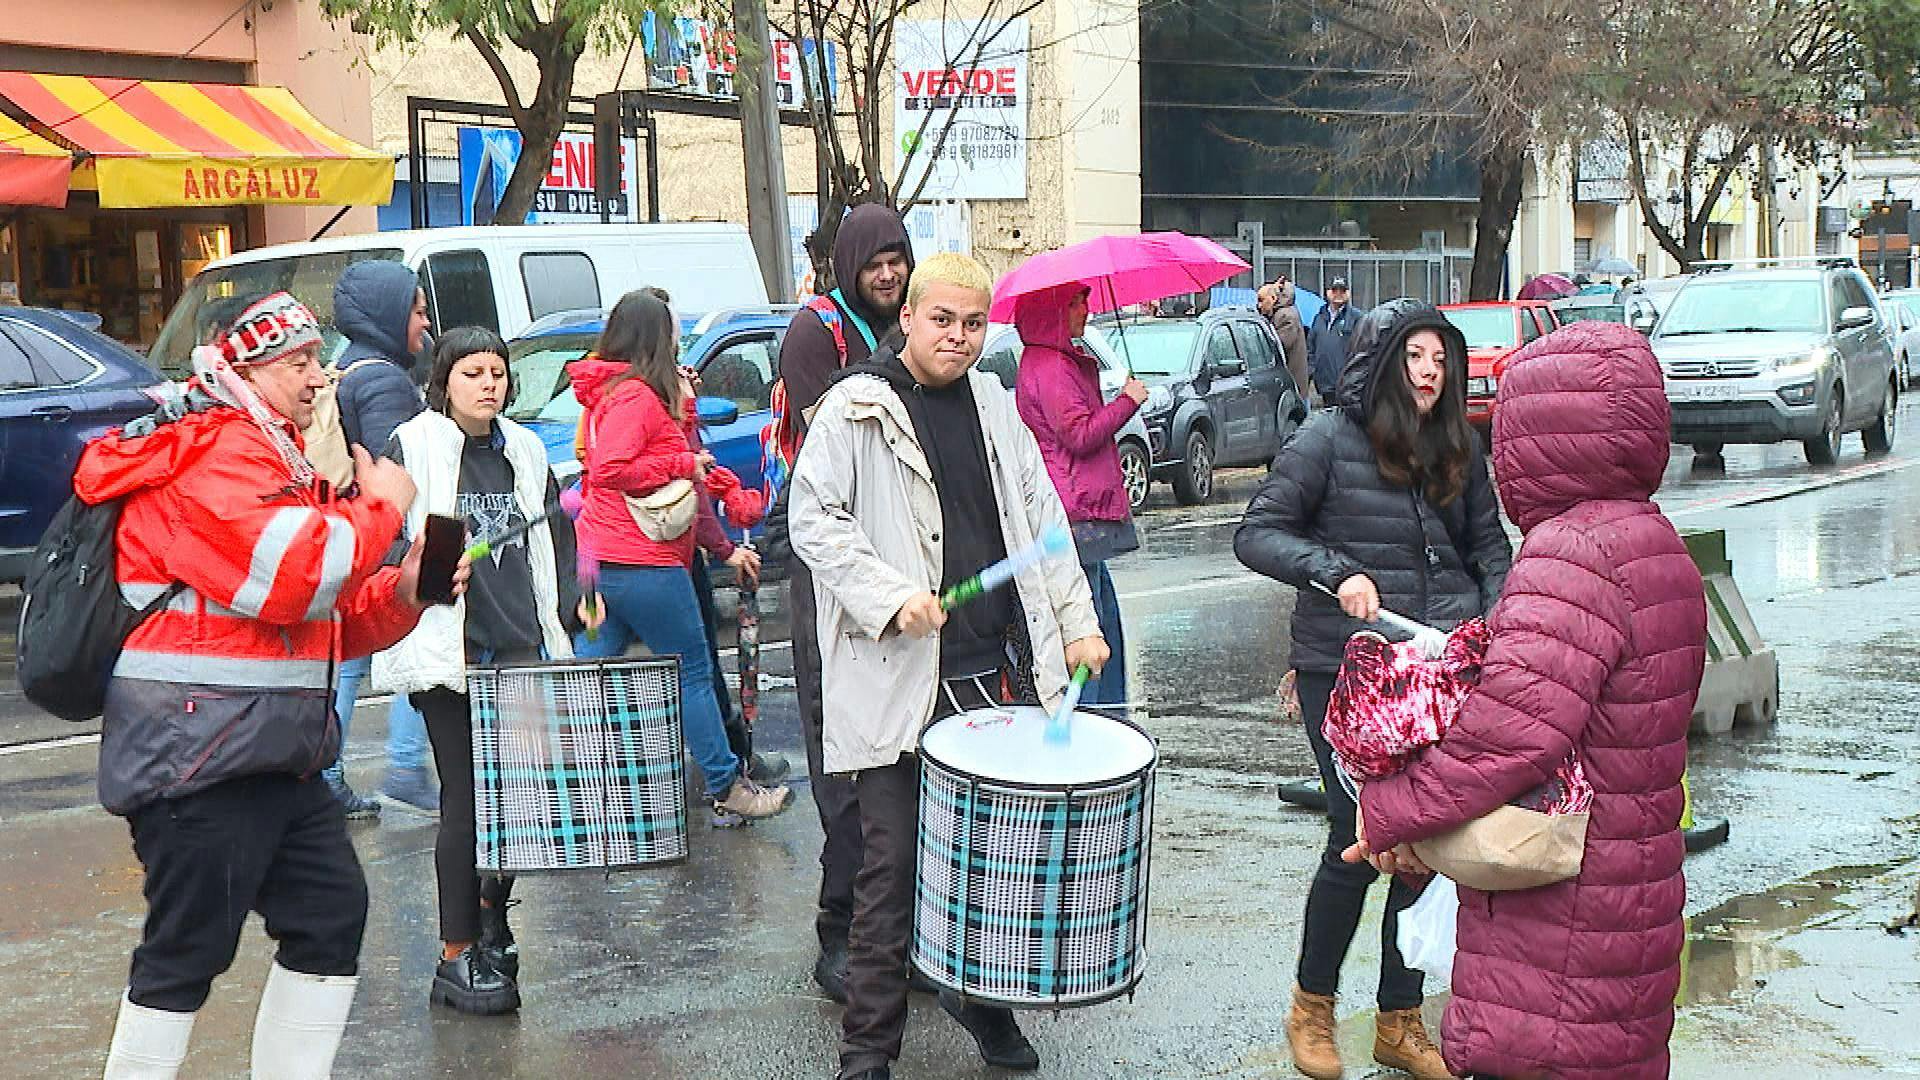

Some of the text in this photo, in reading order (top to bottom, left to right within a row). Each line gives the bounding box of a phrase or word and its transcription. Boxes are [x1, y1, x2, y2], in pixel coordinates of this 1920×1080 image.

[902, 67, 1016, 97] VENDE
[950, 145, 957, 160] 9
[184, 167, 321, 199] ARCALUZ
[535, 192, 557, 212] SU
